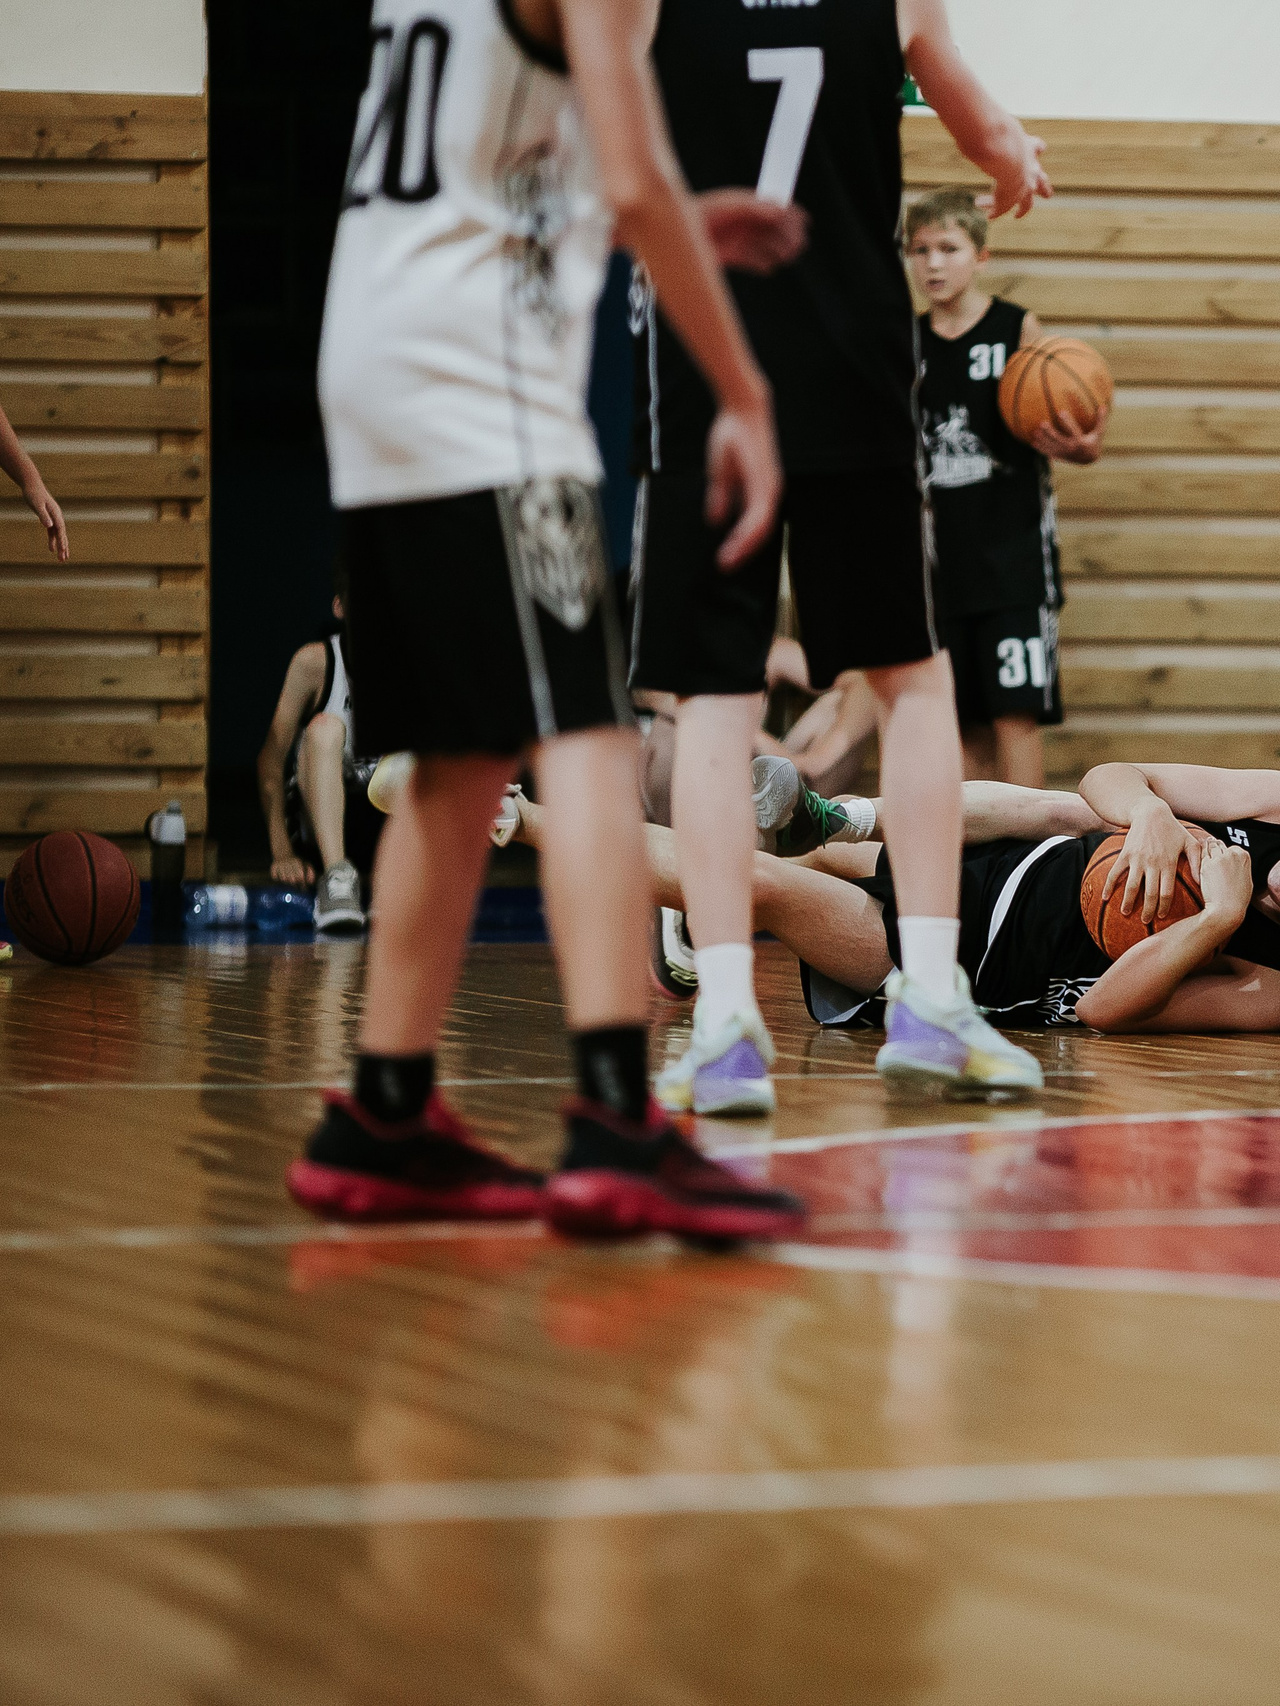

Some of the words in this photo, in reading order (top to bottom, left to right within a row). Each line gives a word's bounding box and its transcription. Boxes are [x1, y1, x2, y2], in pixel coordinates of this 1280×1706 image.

[747, 46, 824, 209] 7
[968, 342, 1007, 381] 31
[997, 637, 1048, 688] 31
